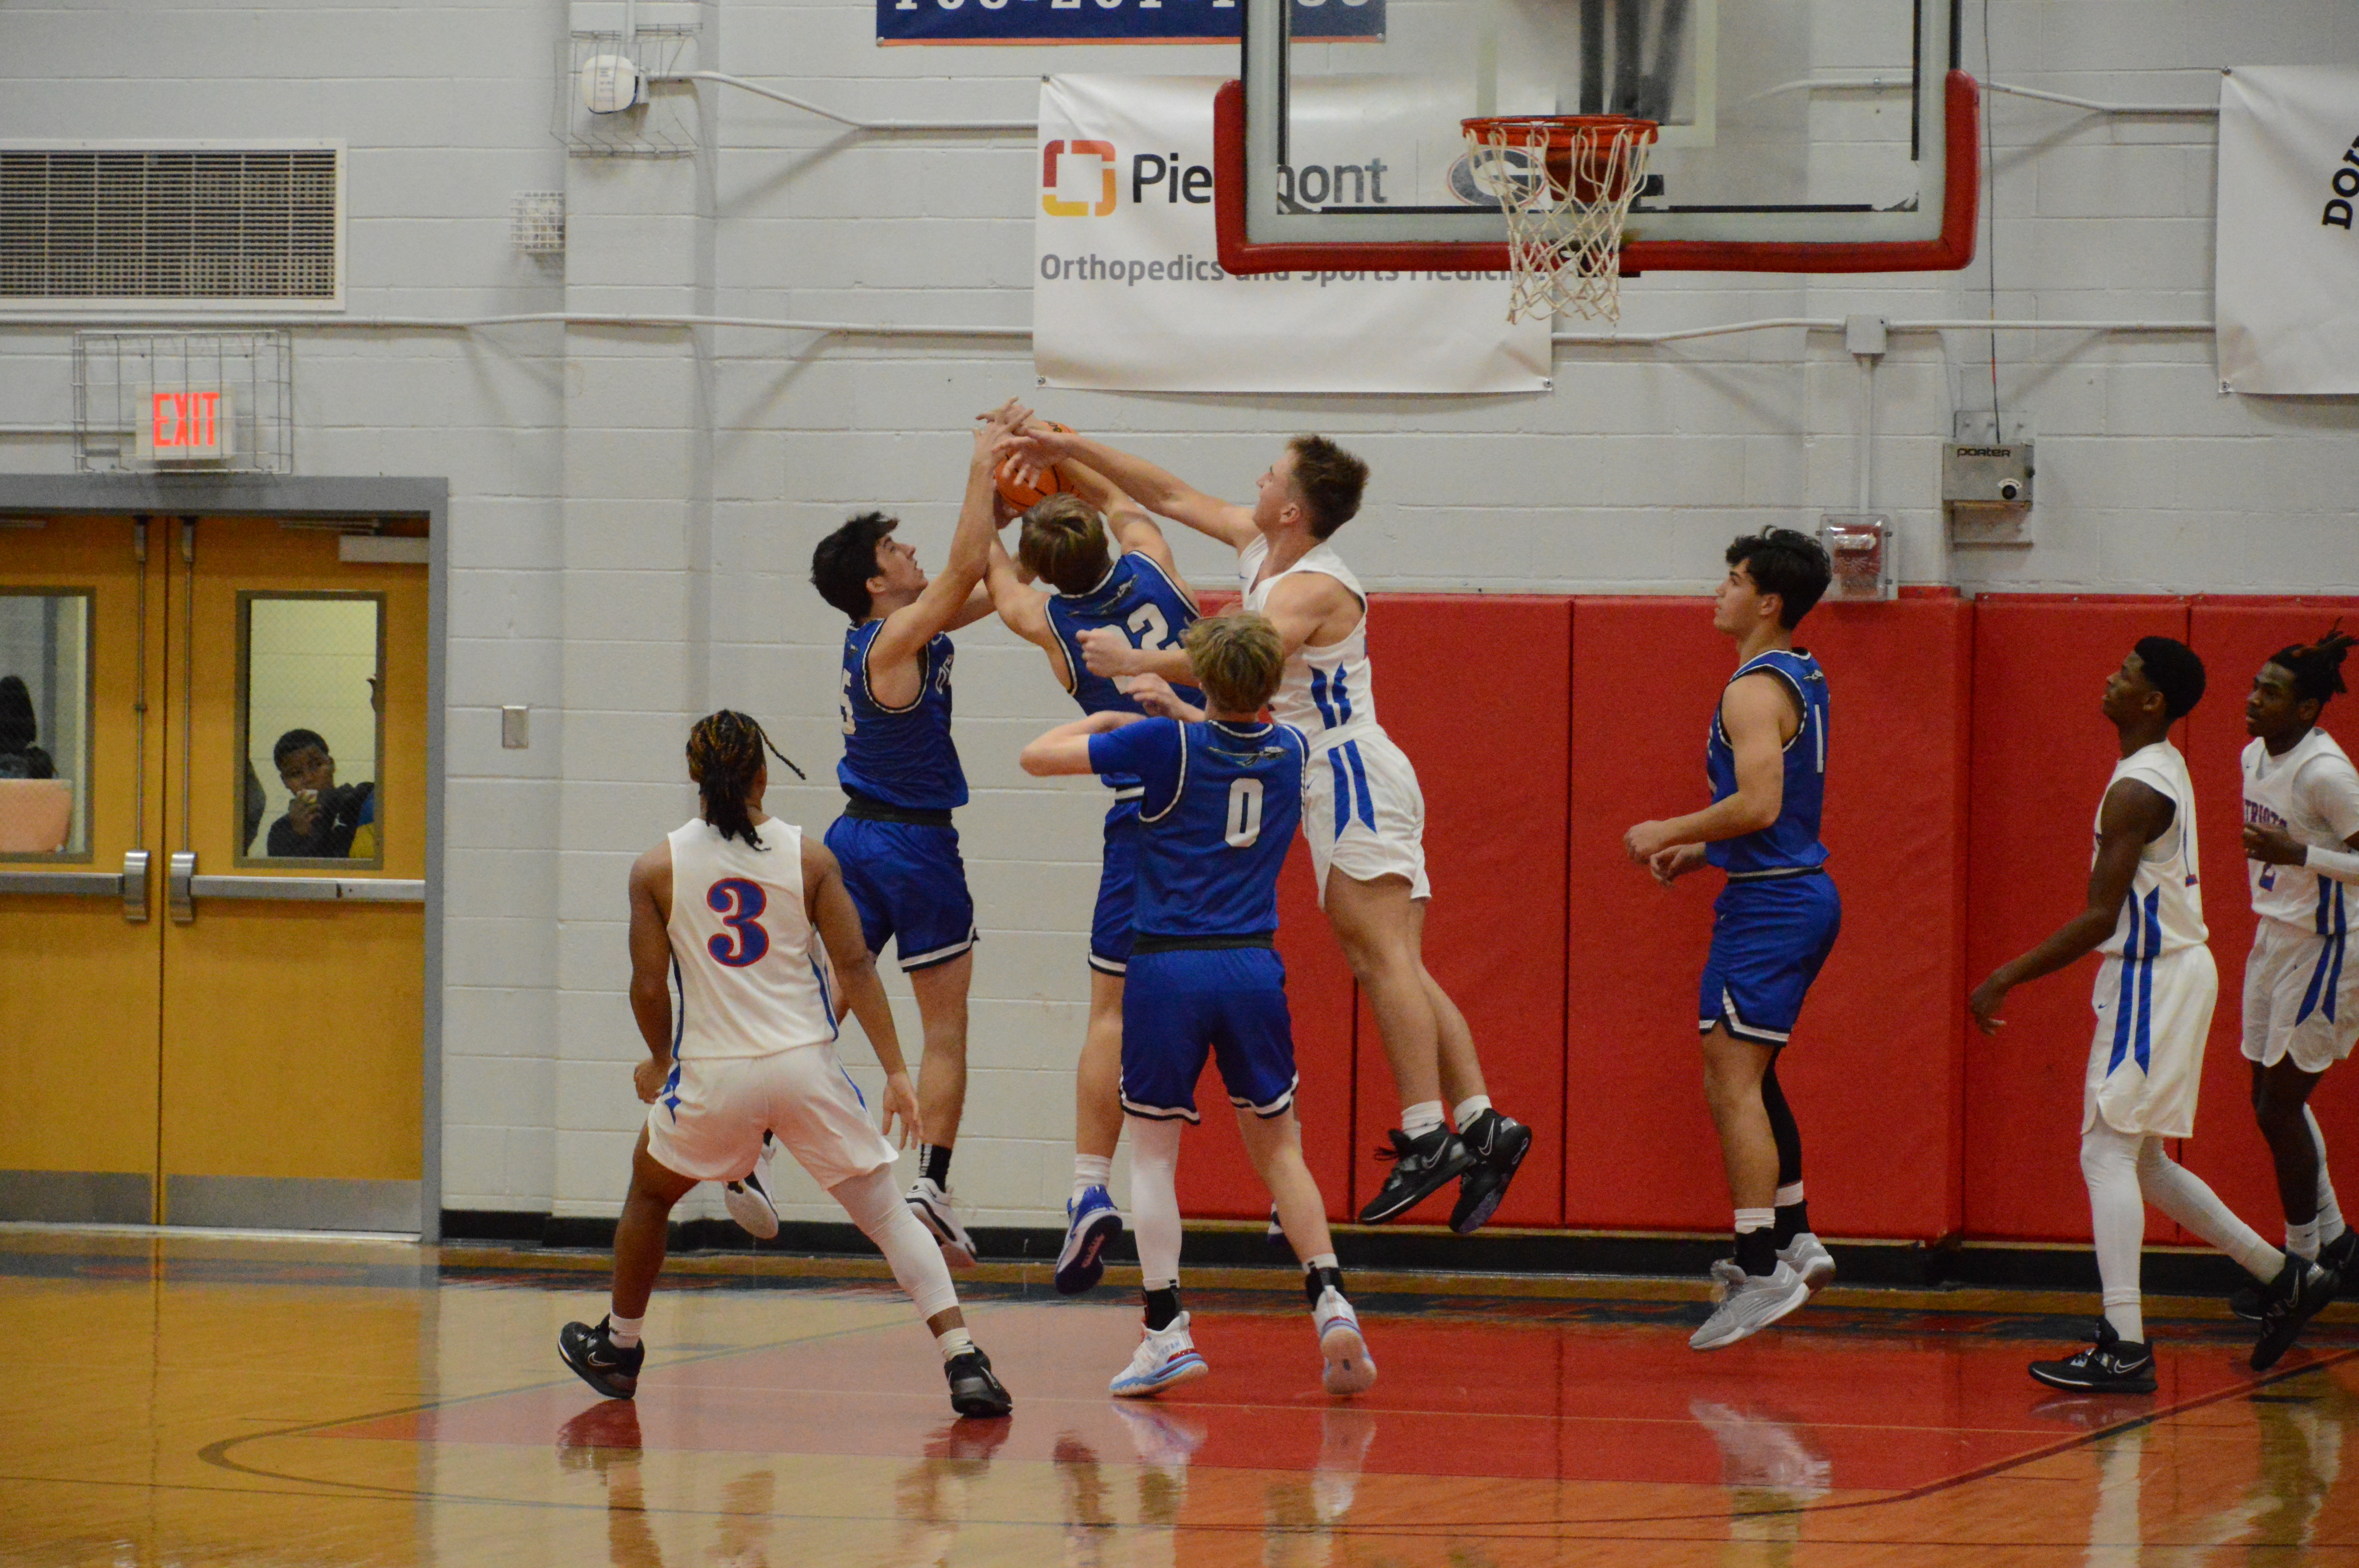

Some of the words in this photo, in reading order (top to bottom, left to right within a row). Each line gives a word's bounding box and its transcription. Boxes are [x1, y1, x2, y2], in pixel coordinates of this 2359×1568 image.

[1132, 153, 1388, 204] Pieont
[1041, 254, 1225, 286] Orthopedics
[153, 392, 219, 447] EXIT
[1225, 778, 1264, 847] 0
[707, 877, 769, 967] 3
